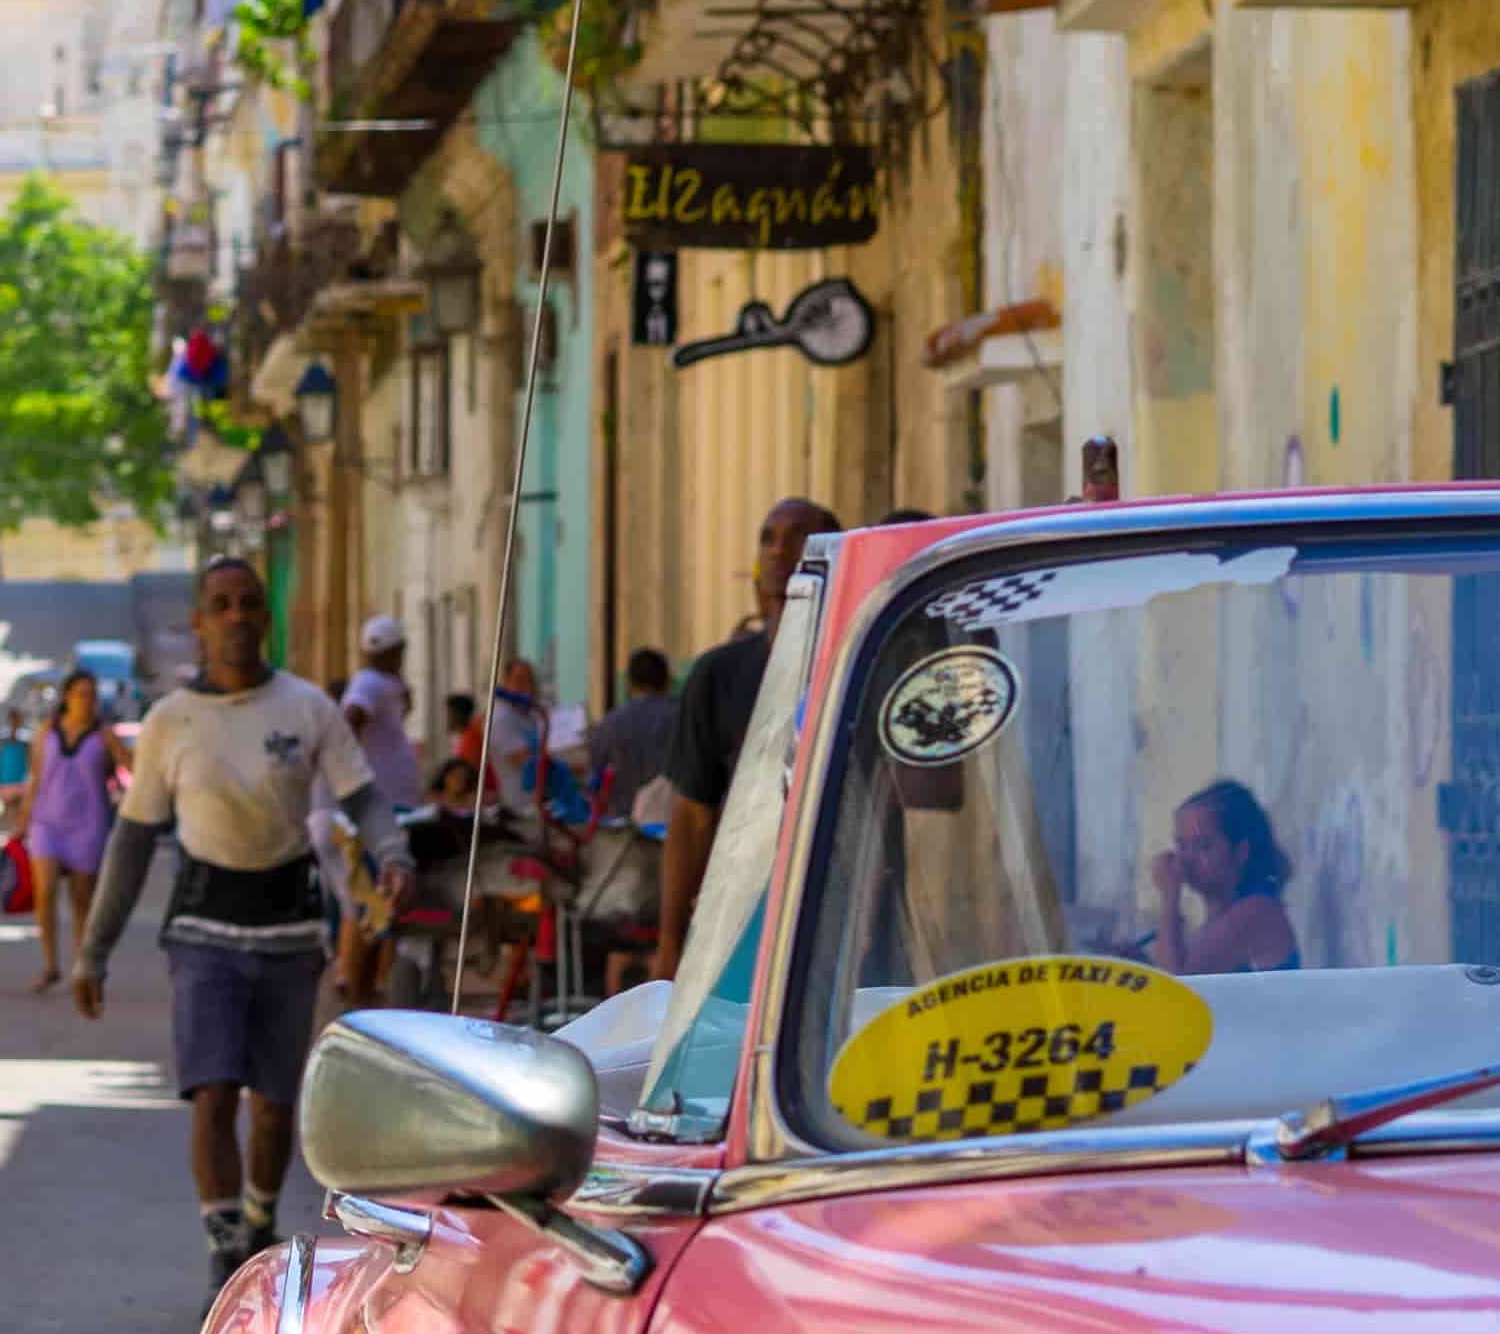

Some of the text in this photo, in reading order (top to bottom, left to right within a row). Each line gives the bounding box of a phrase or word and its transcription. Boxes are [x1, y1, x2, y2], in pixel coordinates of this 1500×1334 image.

[907, 969, 1010, 1018] AGENCIA
[1019, 965, 1049, 984] DE
[1058, 963, 1112, 985] TAXI
[923, 1021, 1116, 1082] H-3264
